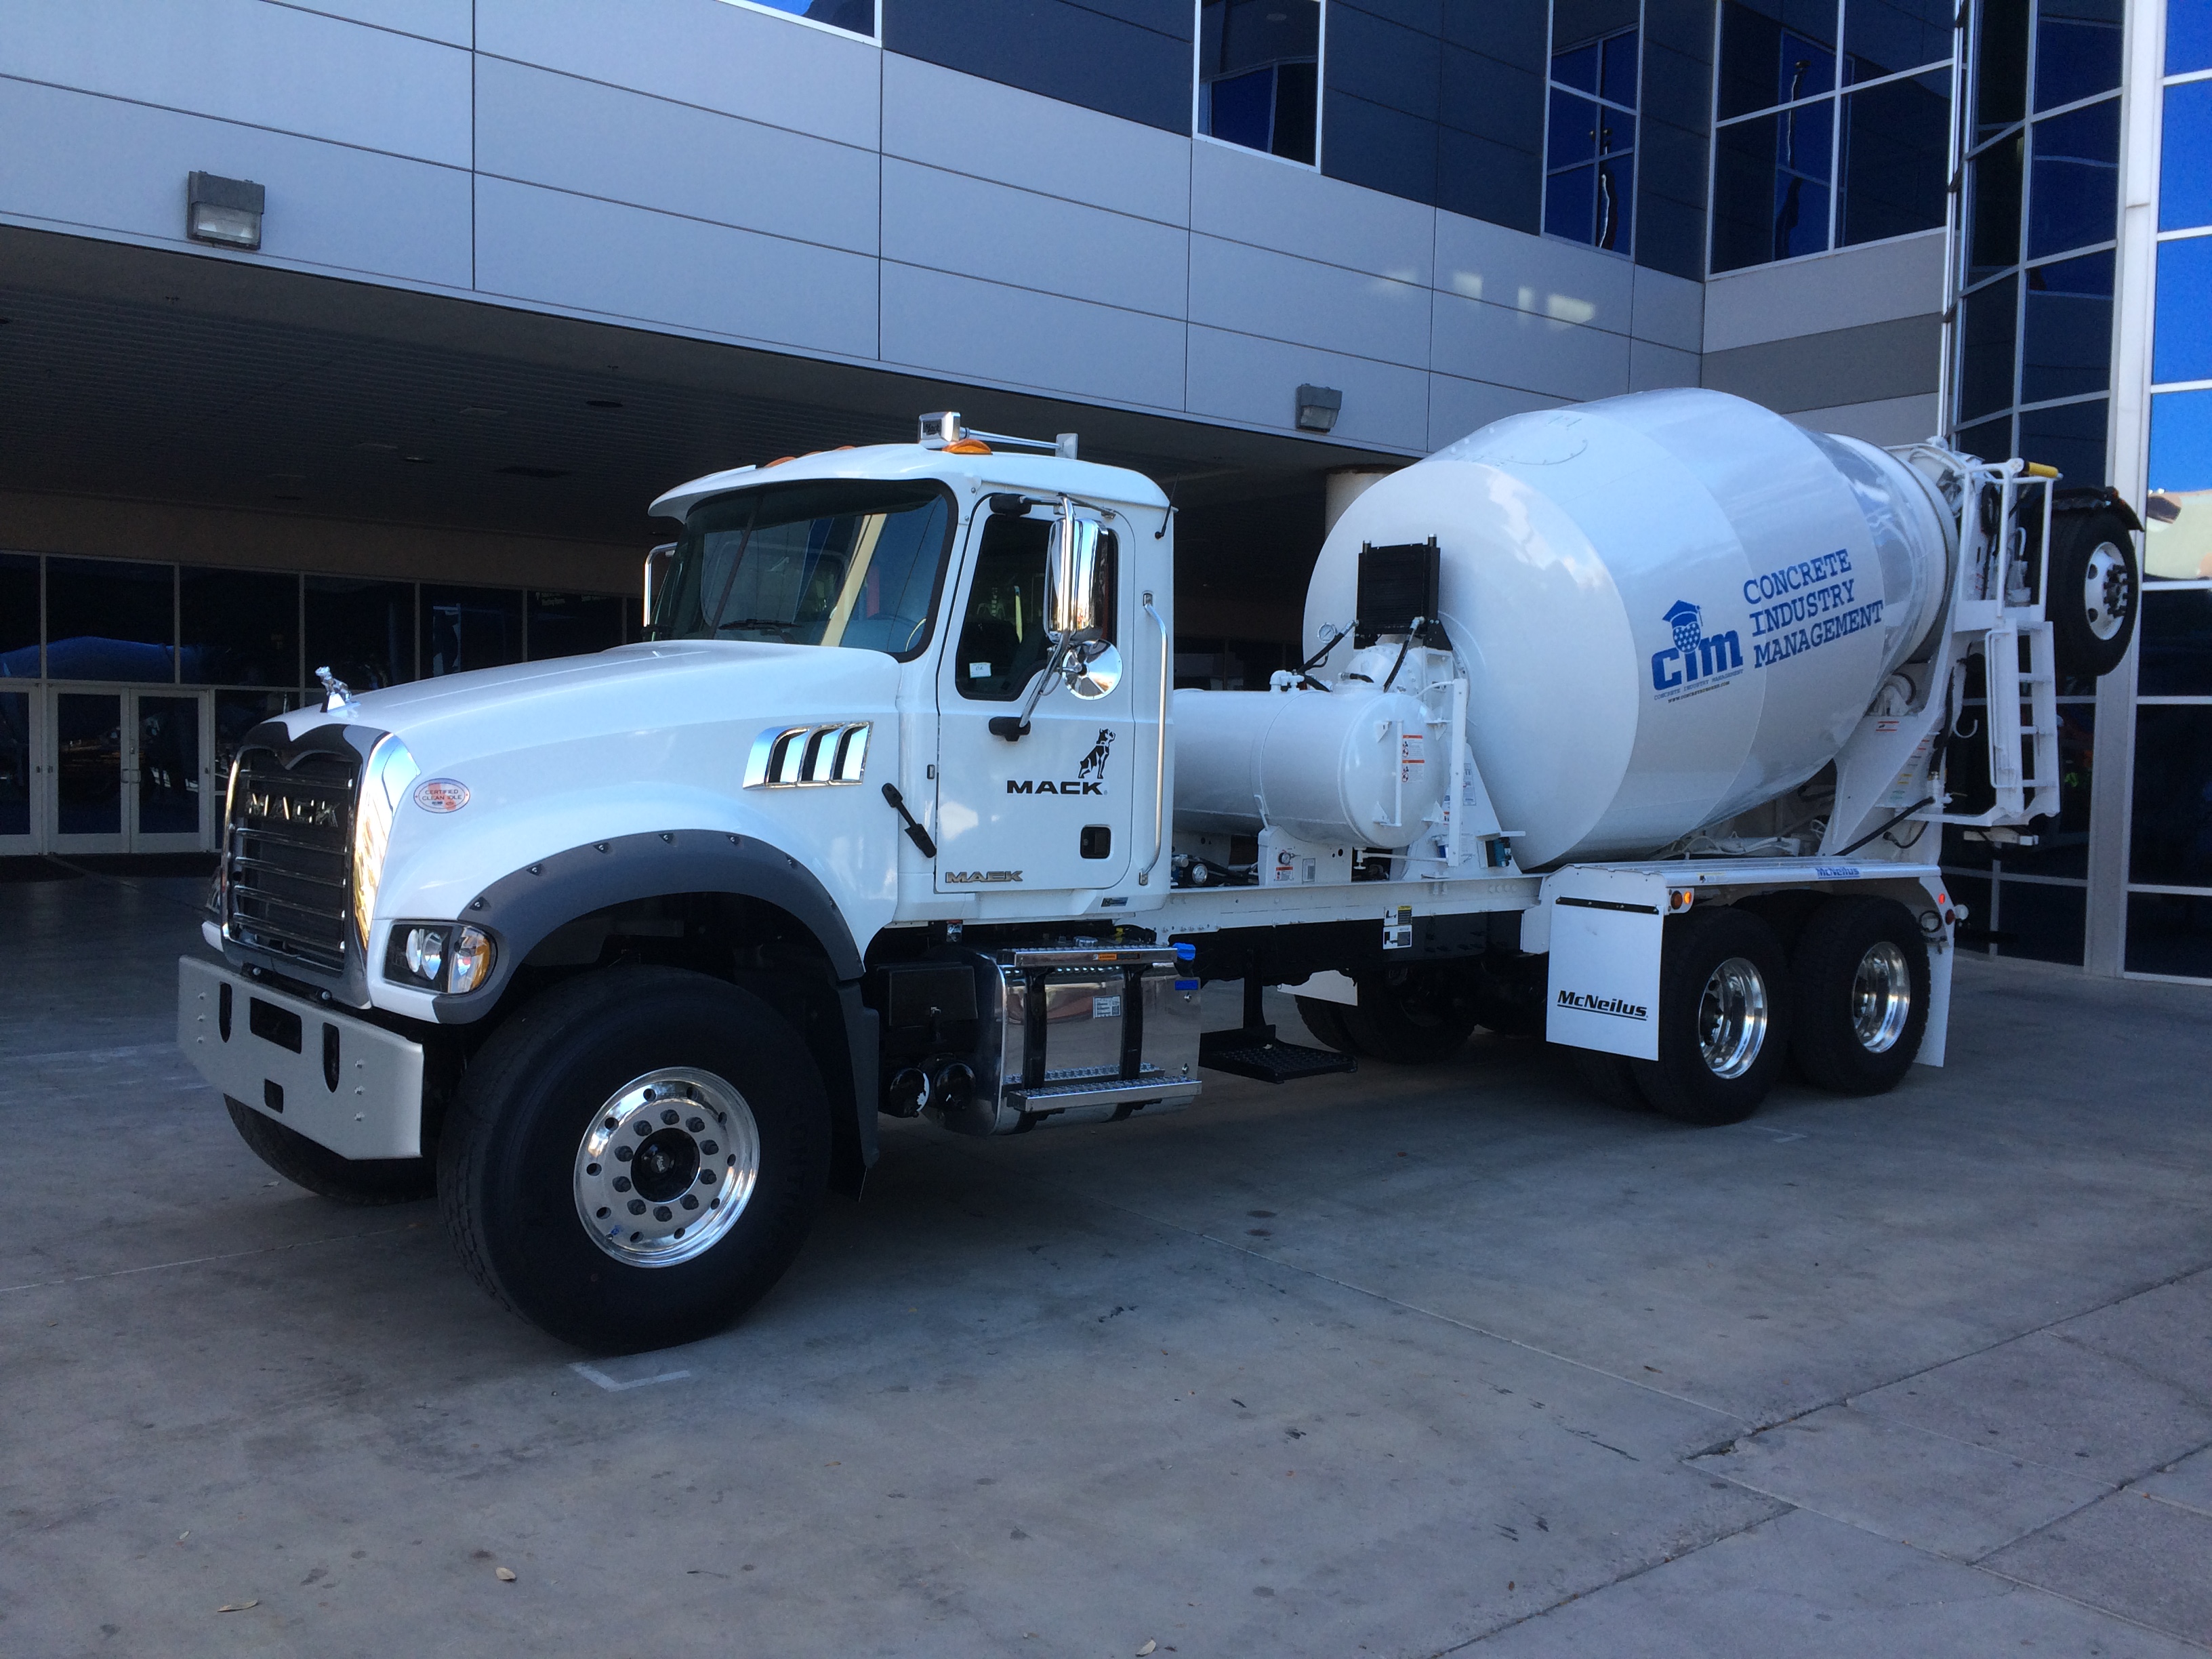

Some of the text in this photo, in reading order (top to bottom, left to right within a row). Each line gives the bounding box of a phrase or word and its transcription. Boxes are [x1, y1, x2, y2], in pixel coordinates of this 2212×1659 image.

[1744, 548, 1851, 605] CONCRETE
[1749, 578, 1854, 637] INDUSTRY
[1753, 600, 1883, 668] MANAGEMENT
[1654, 669, 1744, 701] CONCRETE INDUSTRY MANAGEMENT
[1007, 780, 1103, 795] MACK
[245, 793, 339, 828] MACK
[945, 871, 1023, 883] MACK
[1816, 867, 1860, 876] McNeilus
[1557, 989, 1647, 1017] McNeilus
